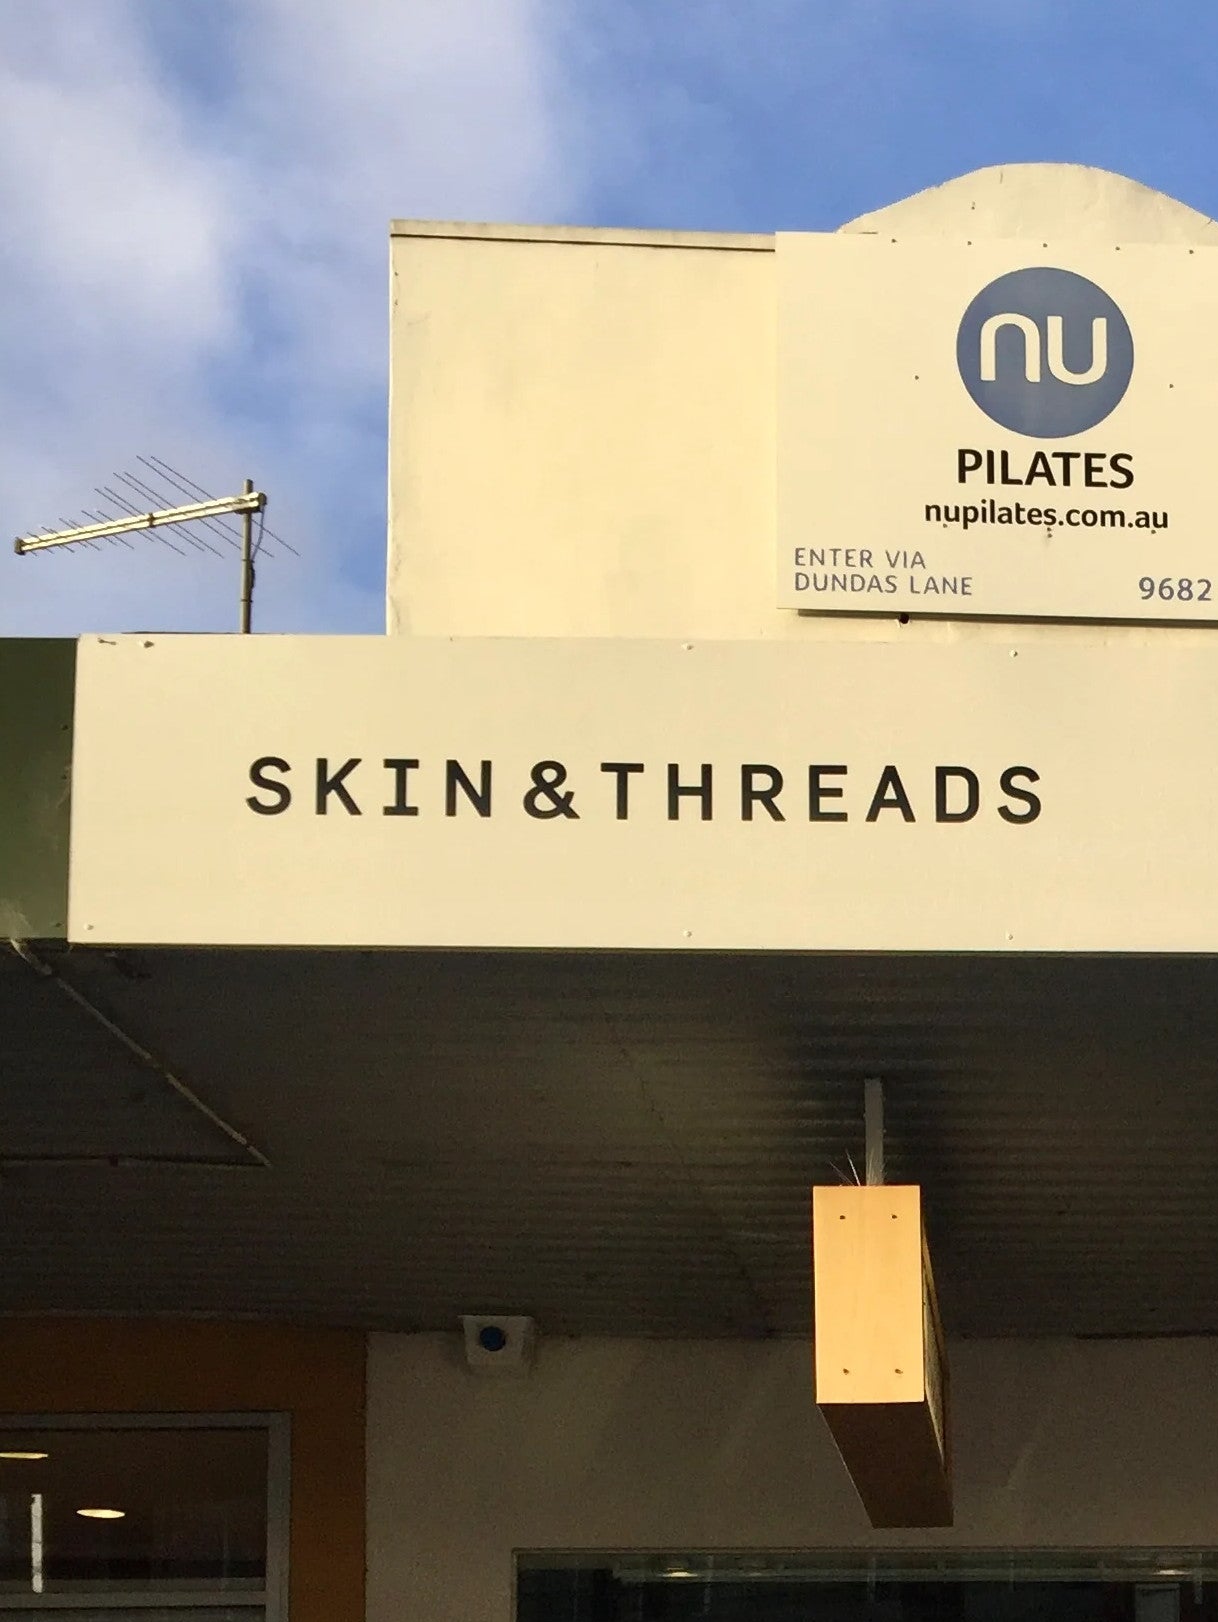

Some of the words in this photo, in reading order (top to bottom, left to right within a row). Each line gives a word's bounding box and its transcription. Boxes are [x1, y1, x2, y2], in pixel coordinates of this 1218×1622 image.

[979, 312, 1108, 386] nu
[957, 448, 1135, 489] PILATES
[924, 498, 1169, 530] nupilates.com.au
[794, 547, 874, 569] ENTER
[885, 550, 926, 570] VIA
[794, 572, 898, 595] DUNDAS
[909, 575, 973, 596] LANE
[1138, 576, 1213, 603] 9682
